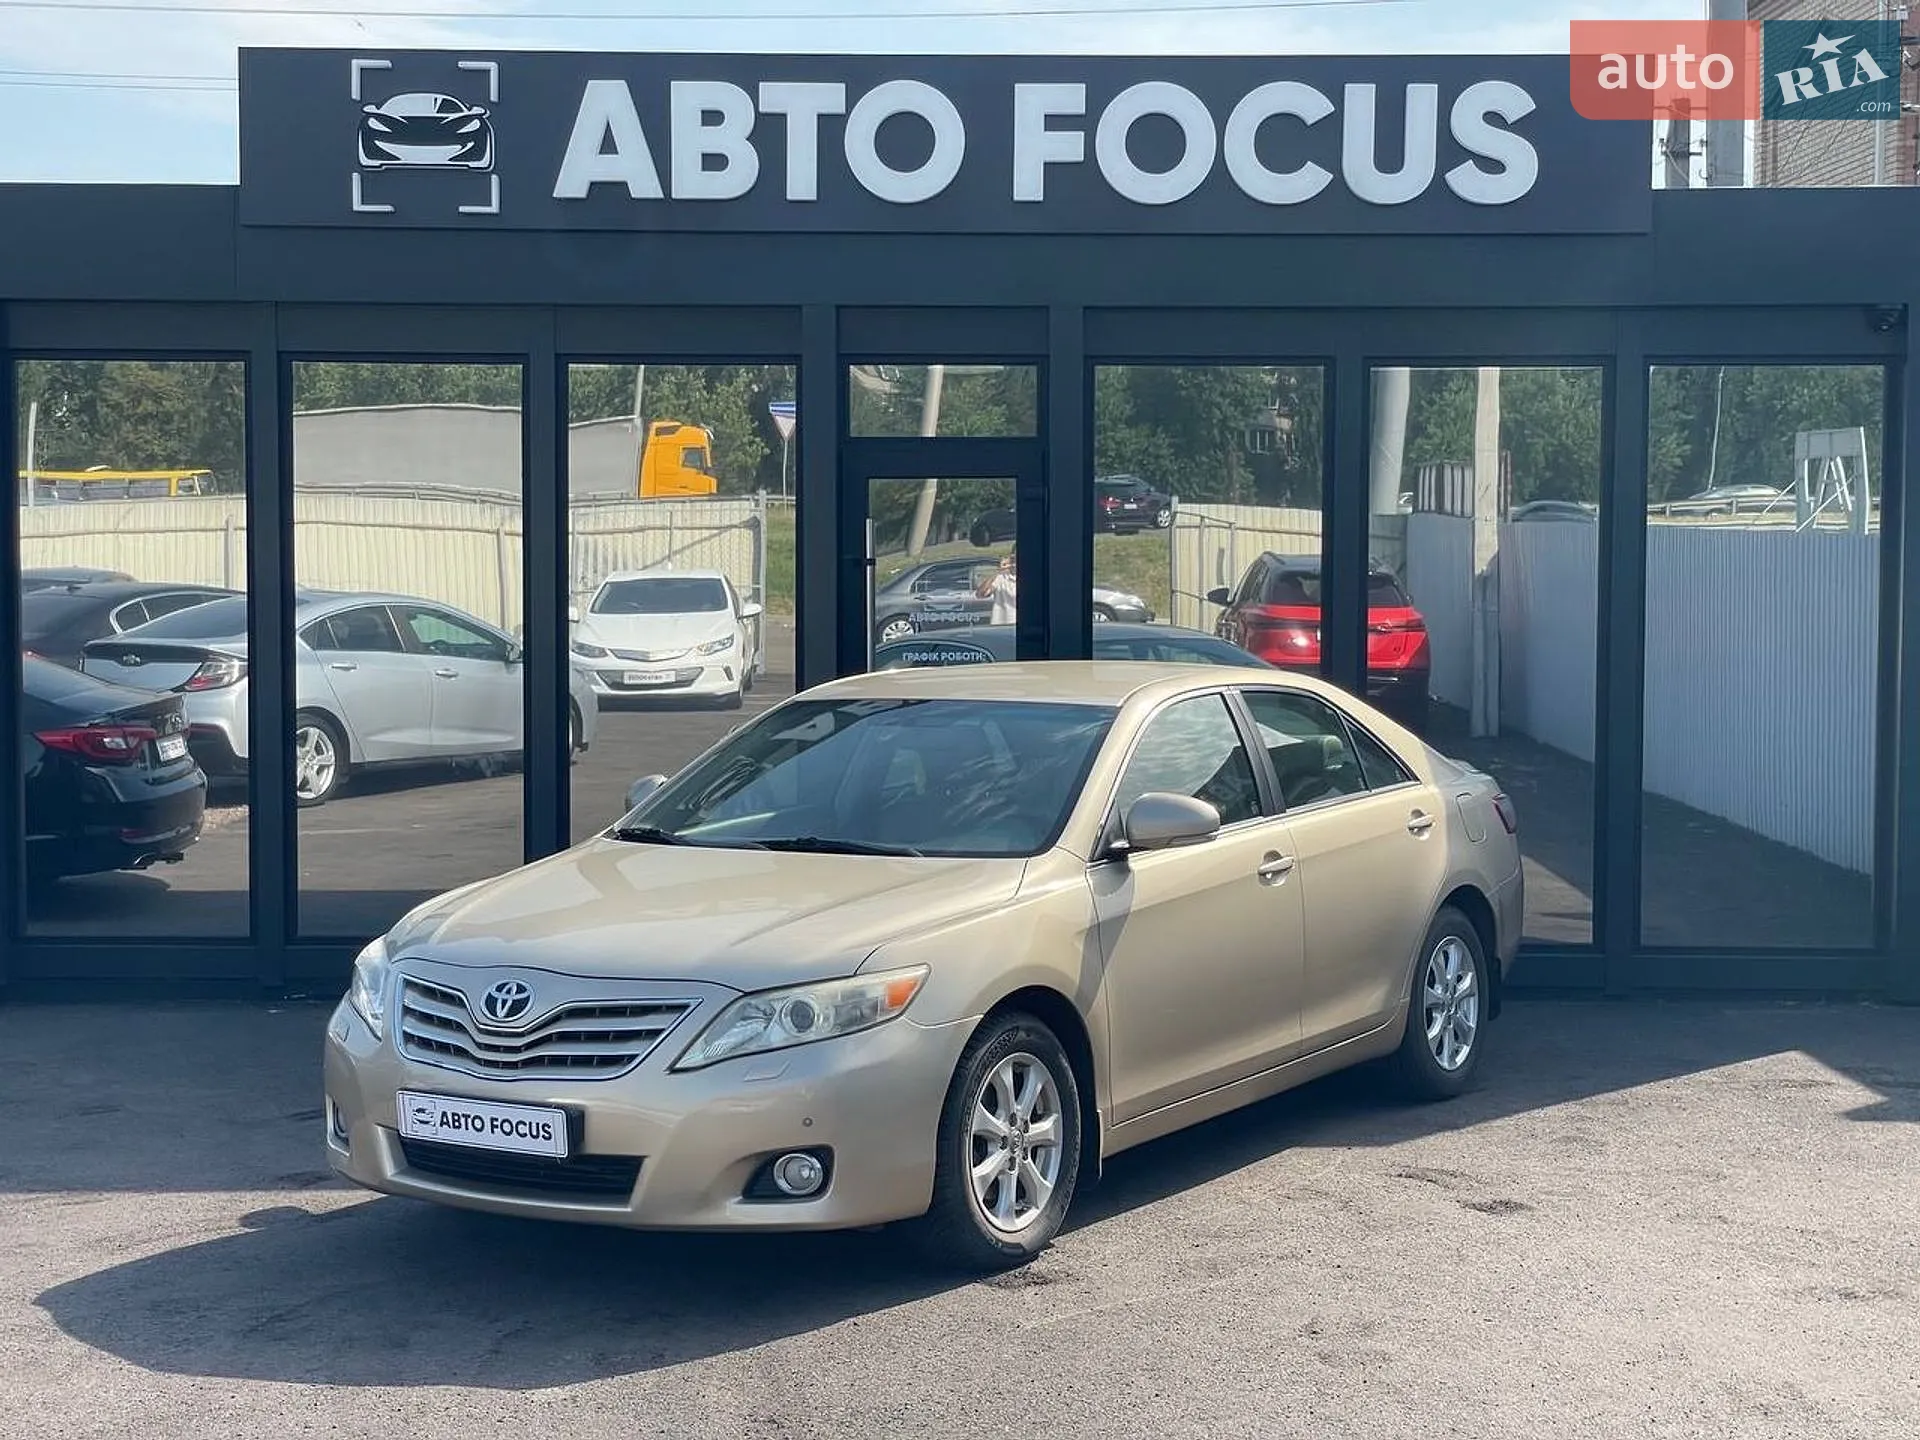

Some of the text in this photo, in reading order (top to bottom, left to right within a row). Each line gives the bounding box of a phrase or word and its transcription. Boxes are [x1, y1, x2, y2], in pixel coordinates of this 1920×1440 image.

[552, 79, 1539, 205] АВТО FOCUS
[439, 1110, 553, 1142] АВТО FOCUS
